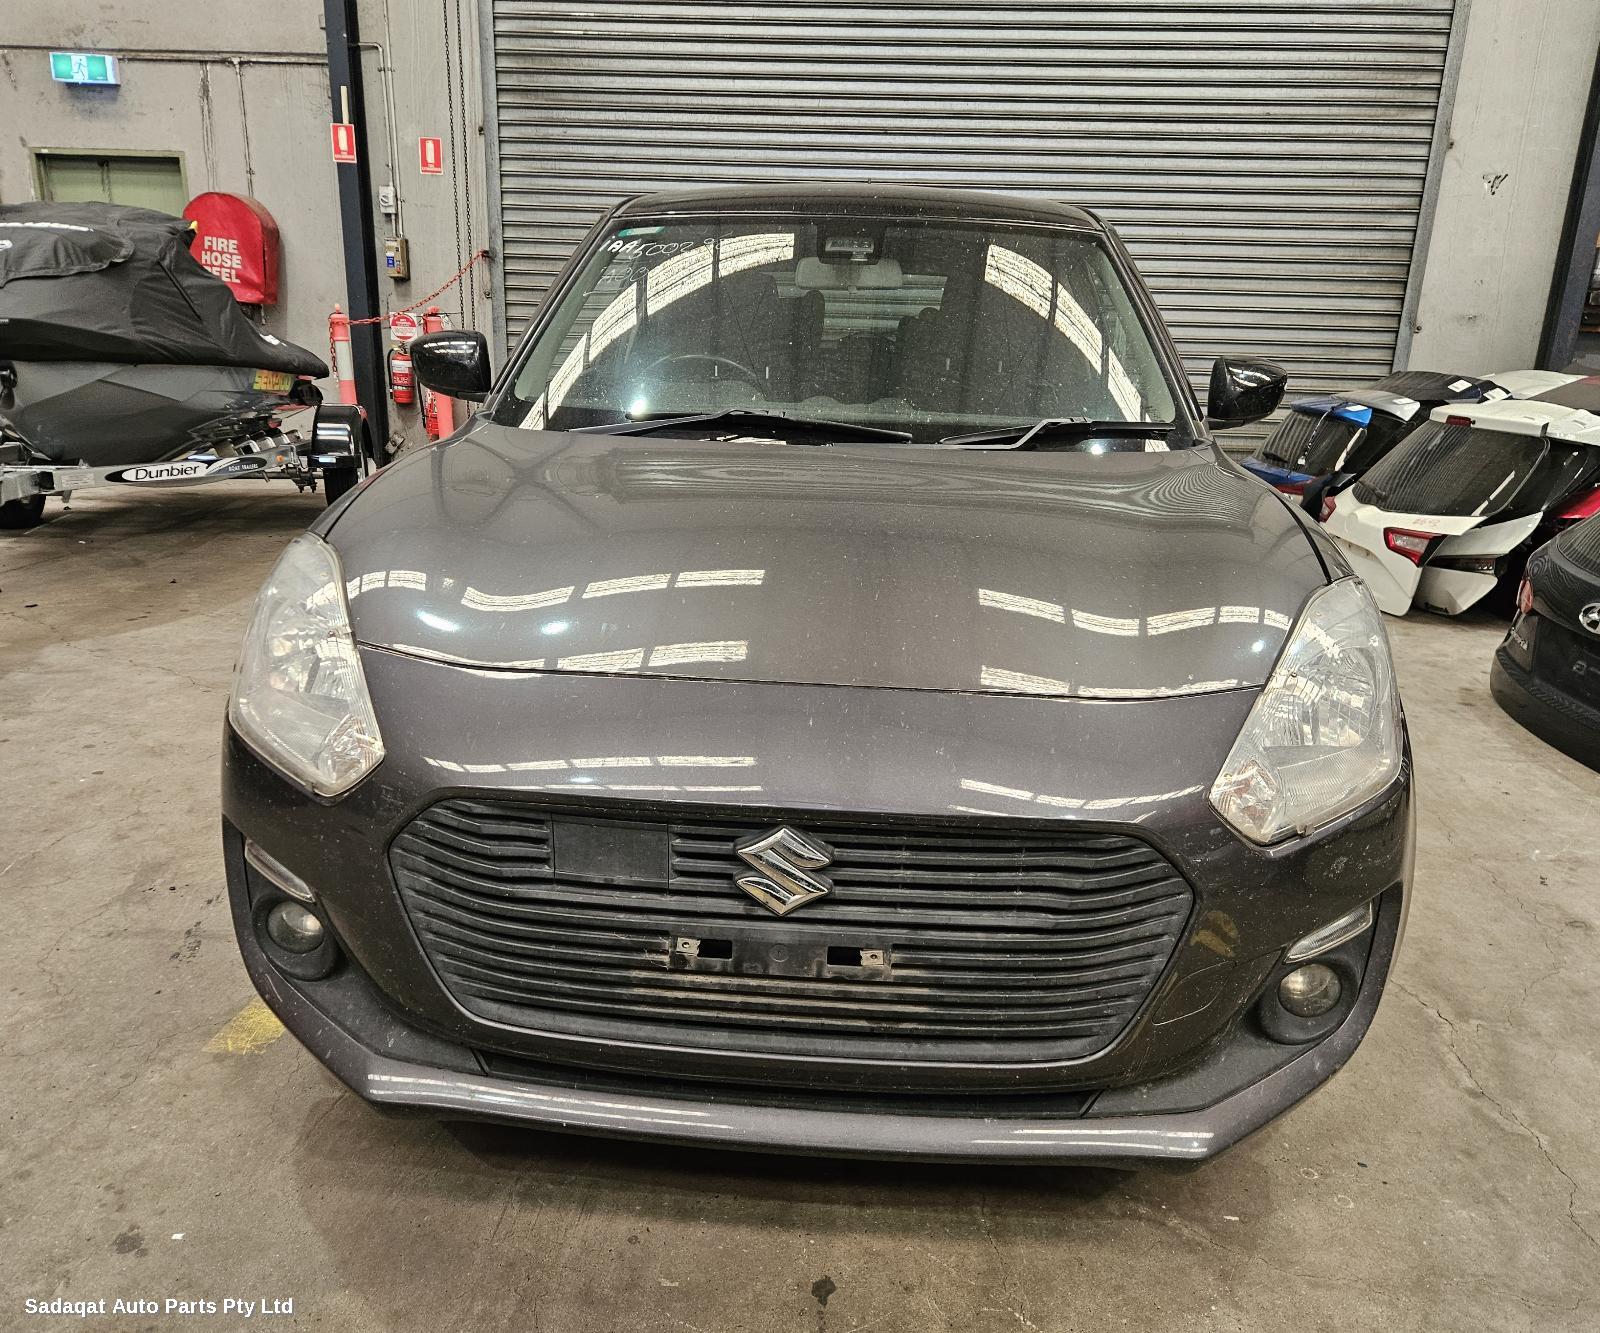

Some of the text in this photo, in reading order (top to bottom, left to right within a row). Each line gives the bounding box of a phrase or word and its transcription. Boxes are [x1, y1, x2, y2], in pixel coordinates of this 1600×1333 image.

[203, 235, 239, 254] FIRE
[201, 250, 242, 269] HOSE
[134, 464, 199, 481] Dunbier
